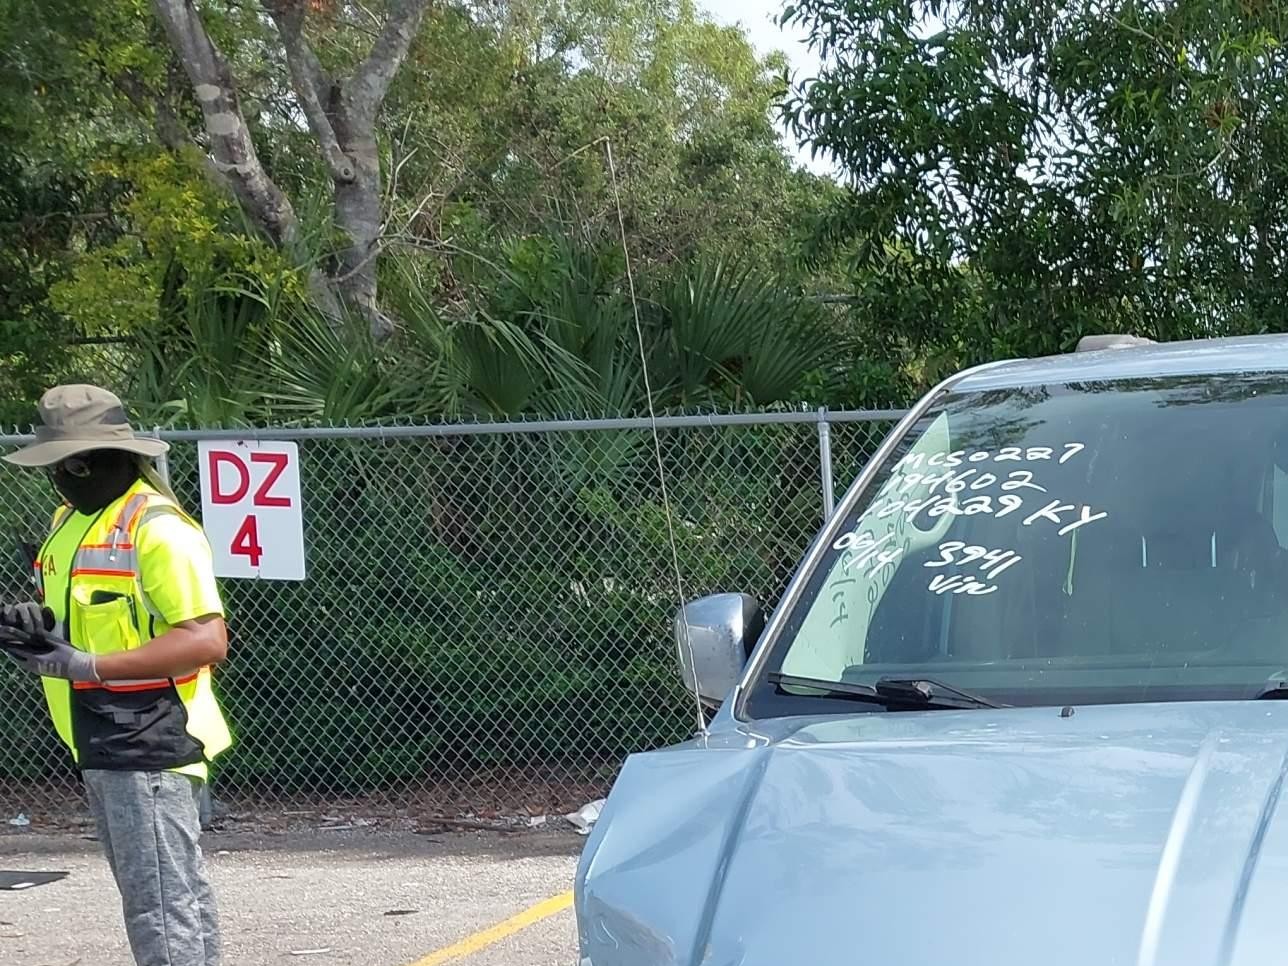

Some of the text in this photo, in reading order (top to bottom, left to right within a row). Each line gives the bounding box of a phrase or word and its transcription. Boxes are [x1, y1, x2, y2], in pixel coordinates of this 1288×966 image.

[208, 450, 291, 508] DZ
[230, 515, 263, 567] 4
[1023, 500, 1108, 536] KY
